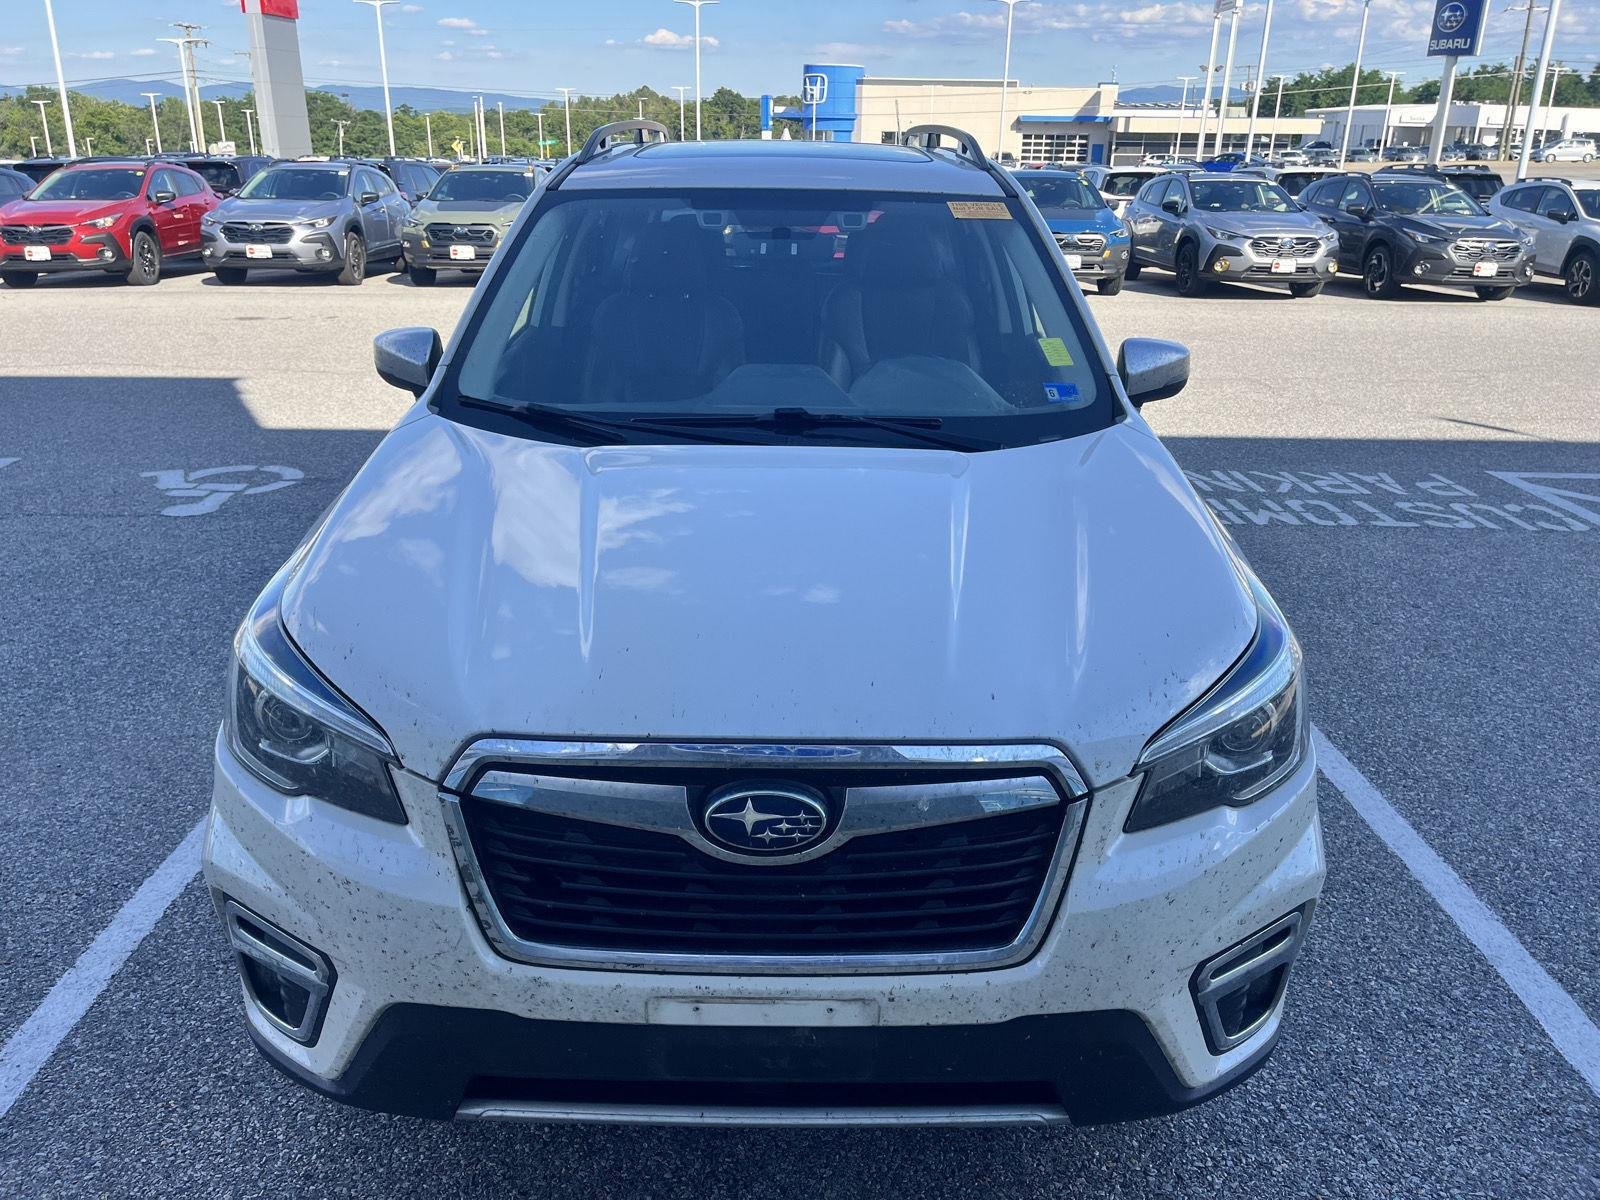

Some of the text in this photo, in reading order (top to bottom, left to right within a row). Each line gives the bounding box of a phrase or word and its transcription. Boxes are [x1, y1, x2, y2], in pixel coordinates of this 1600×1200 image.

[1430, 38, 1470, 50] SUBARU
[1048, 389, 1056, 398] 6
[1184, 470, 1479, 496] PARKIN
